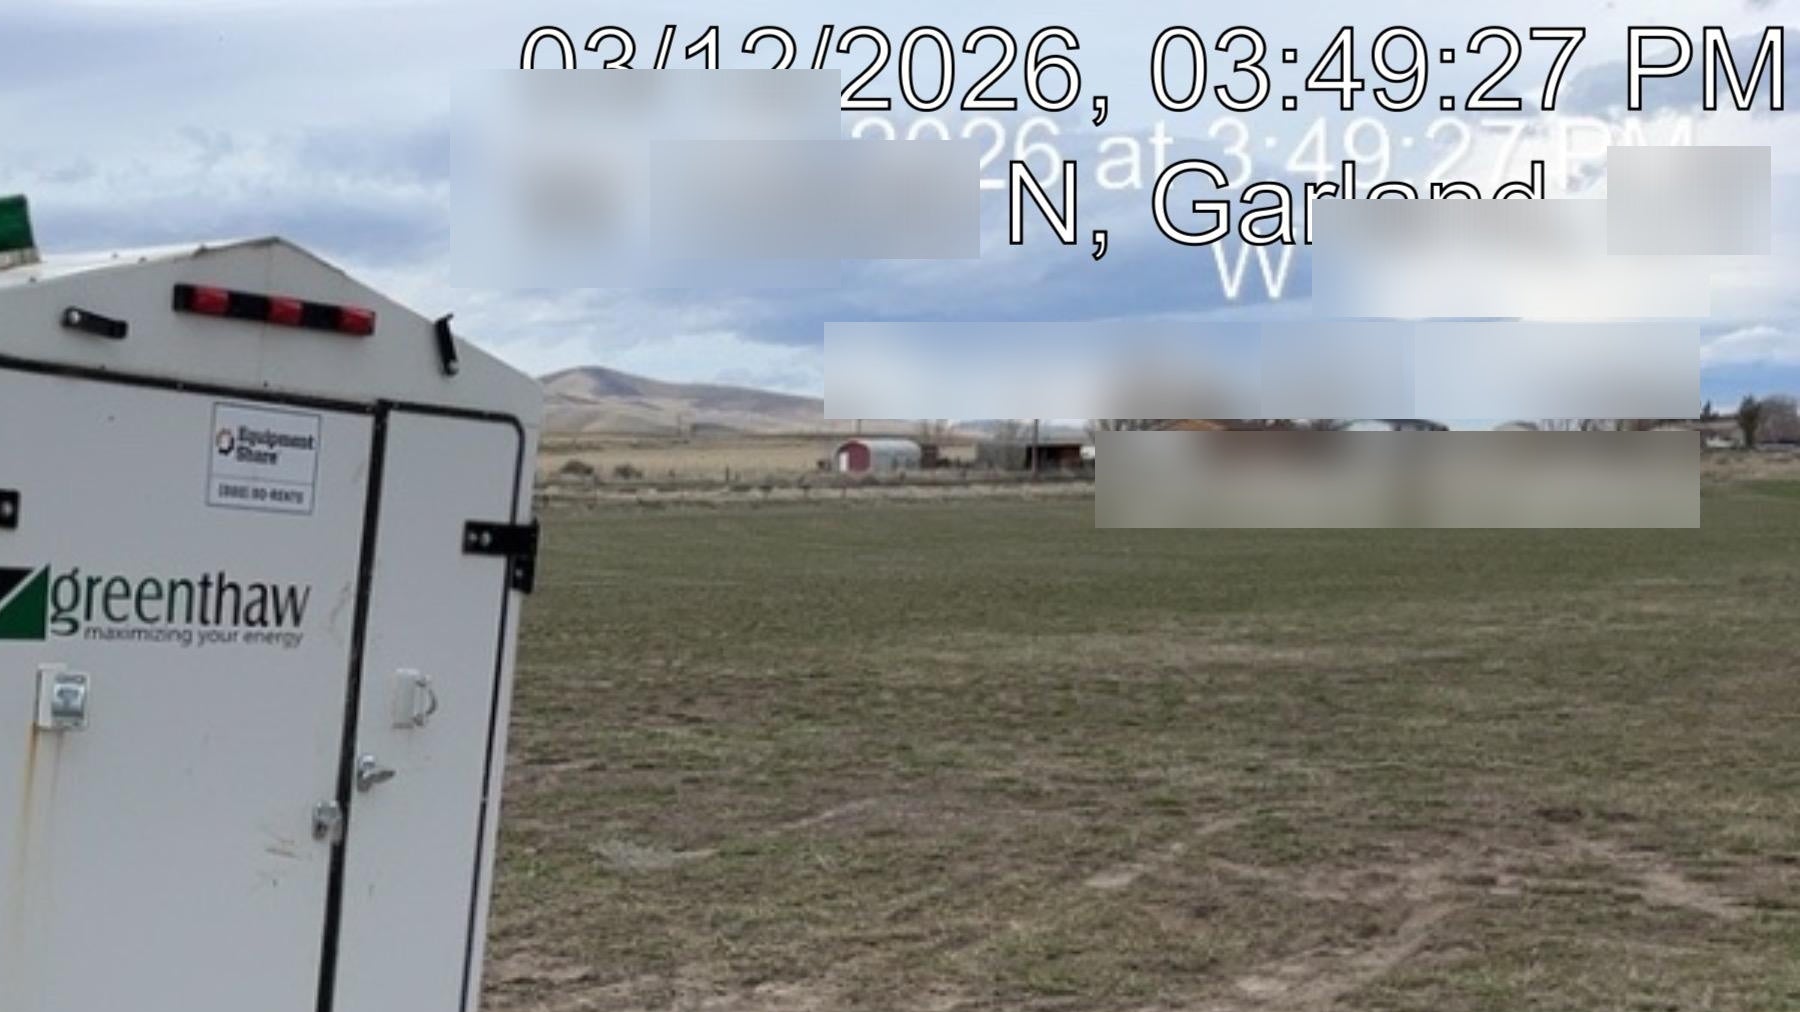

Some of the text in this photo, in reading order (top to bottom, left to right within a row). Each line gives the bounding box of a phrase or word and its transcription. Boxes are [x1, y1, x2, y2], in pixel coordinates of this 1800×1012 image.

[238, 424, 314, 450] Equipment
[50, 566, 312, 638] greenthaw
[83, 624, 304, 649] maximizing your energy
